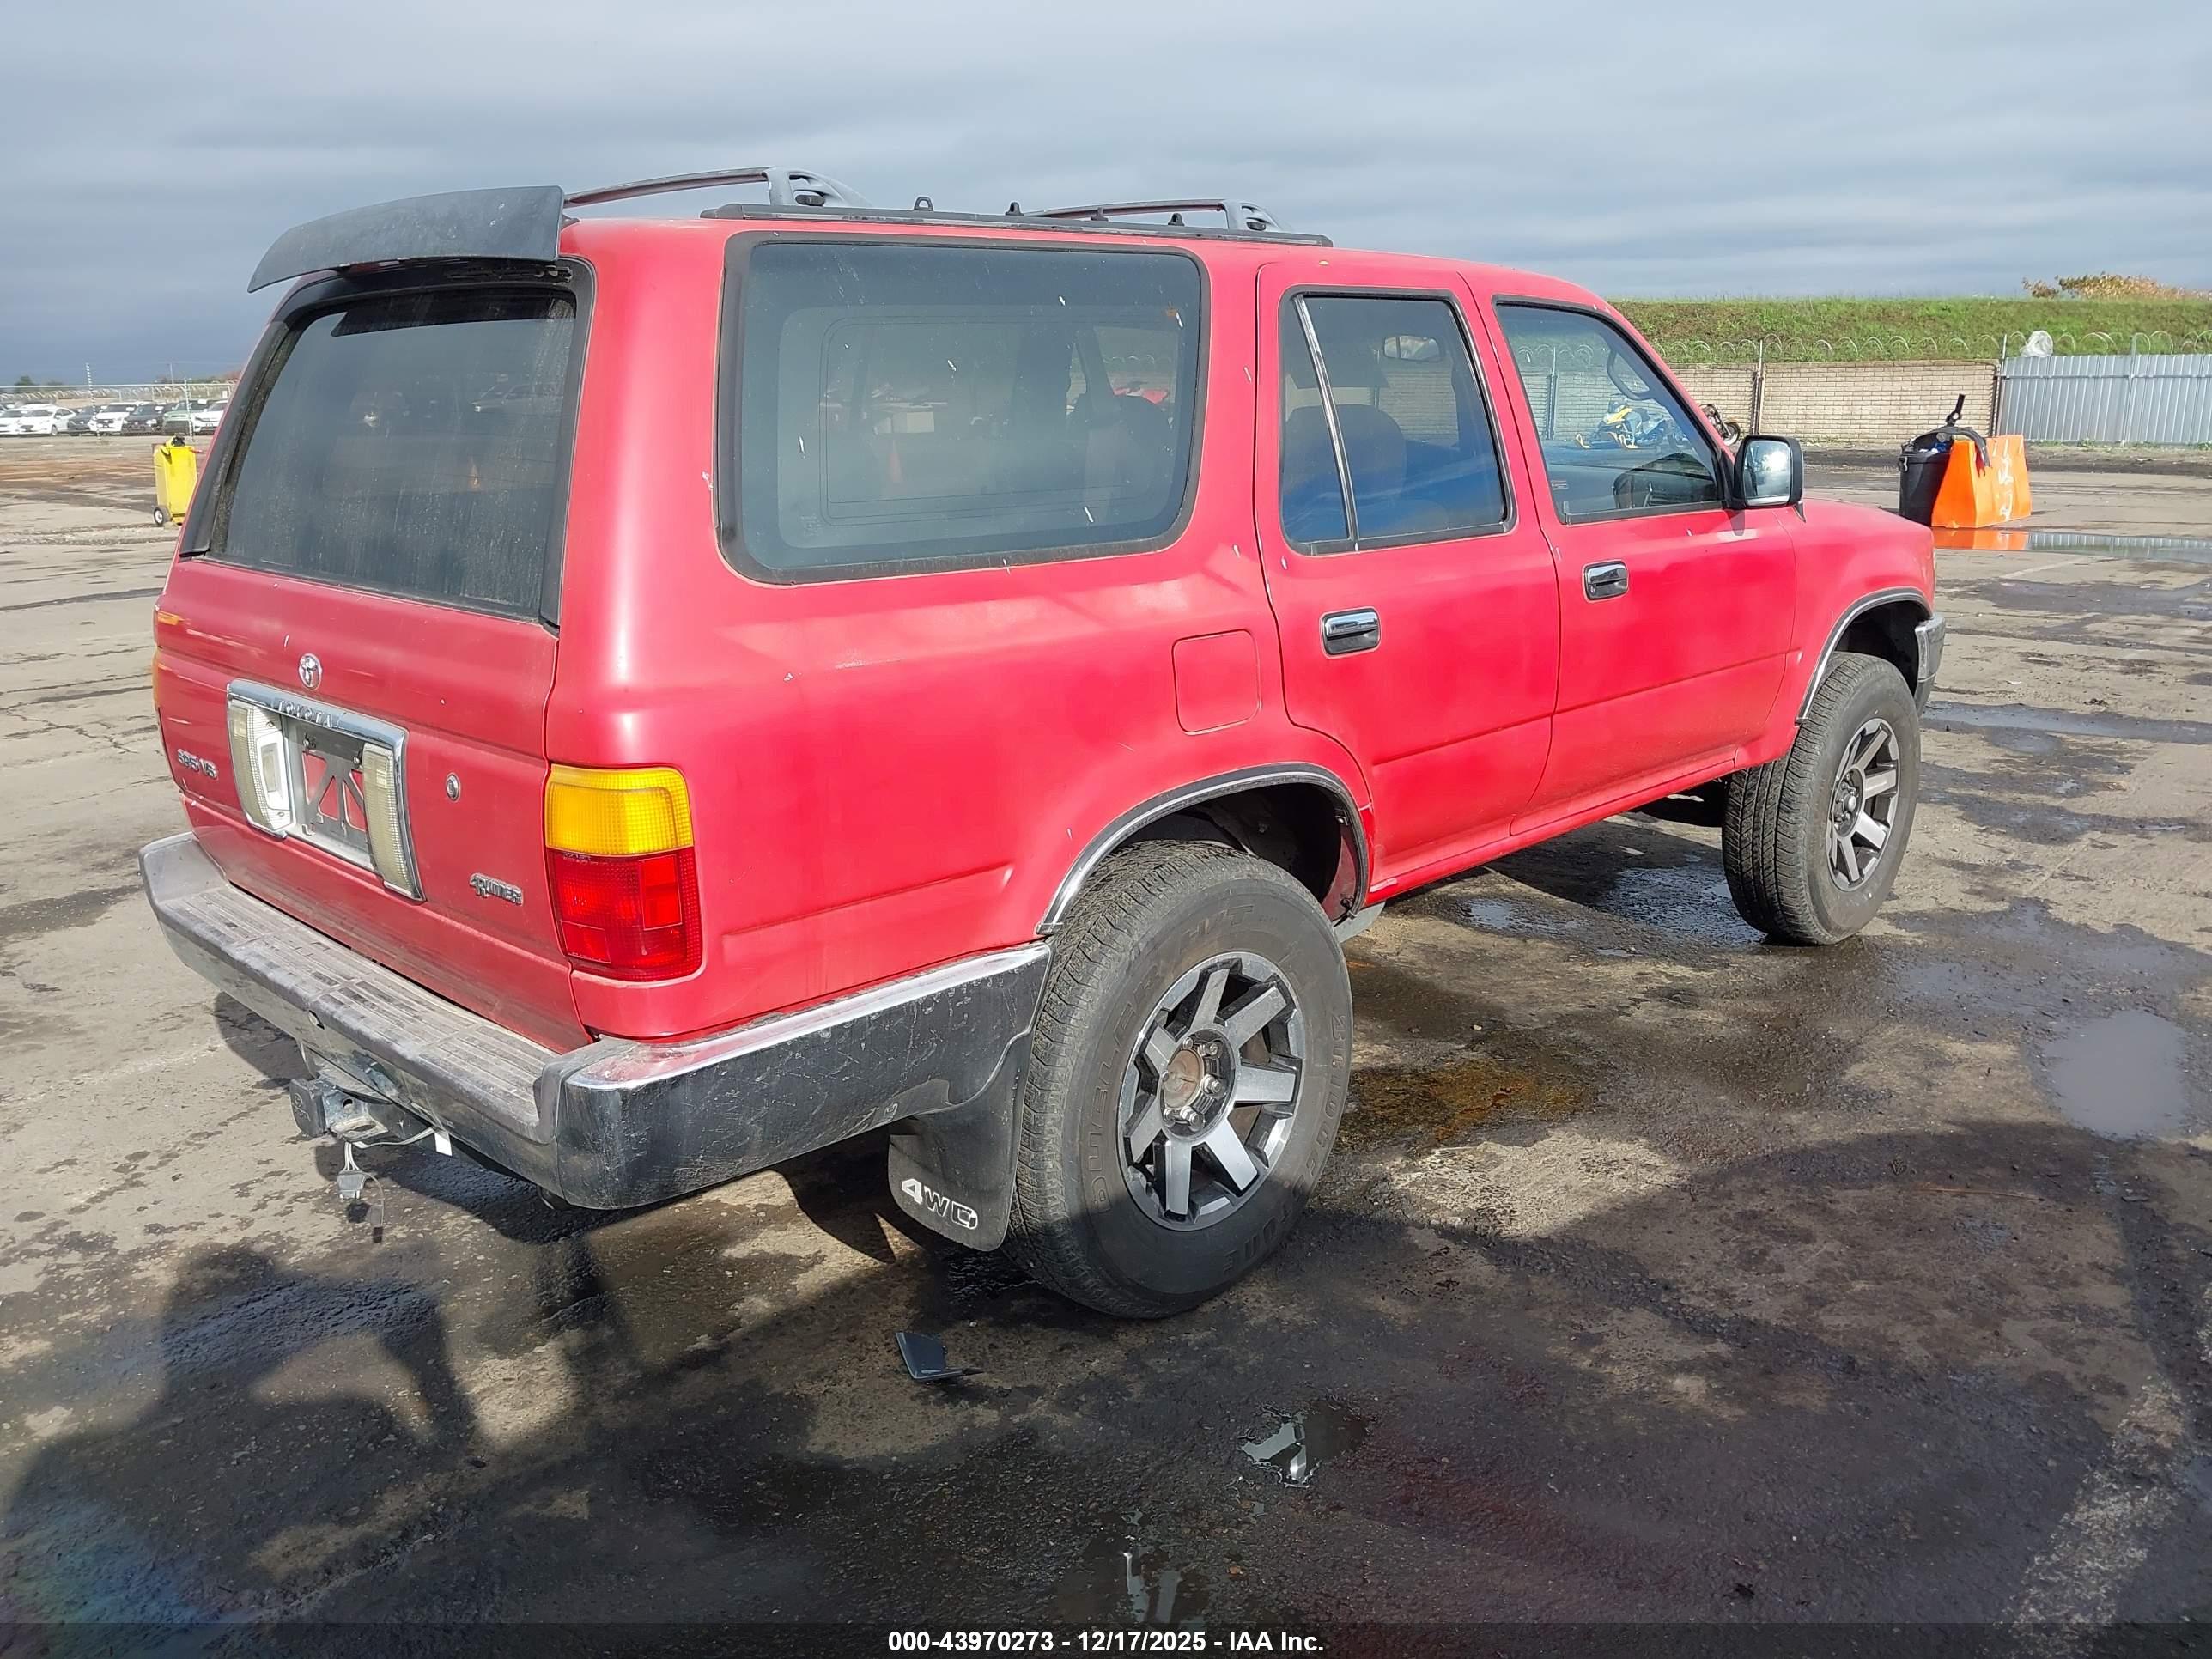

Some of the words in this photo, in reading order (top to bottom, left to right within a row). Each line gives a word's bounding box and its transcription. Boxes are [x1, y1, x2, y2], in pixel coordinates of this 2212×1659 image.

[278, 700, 332, 728] TOYOTA
[199, 758, 218, 779] V6
[901, 1177, 979, 1231] 4WD
